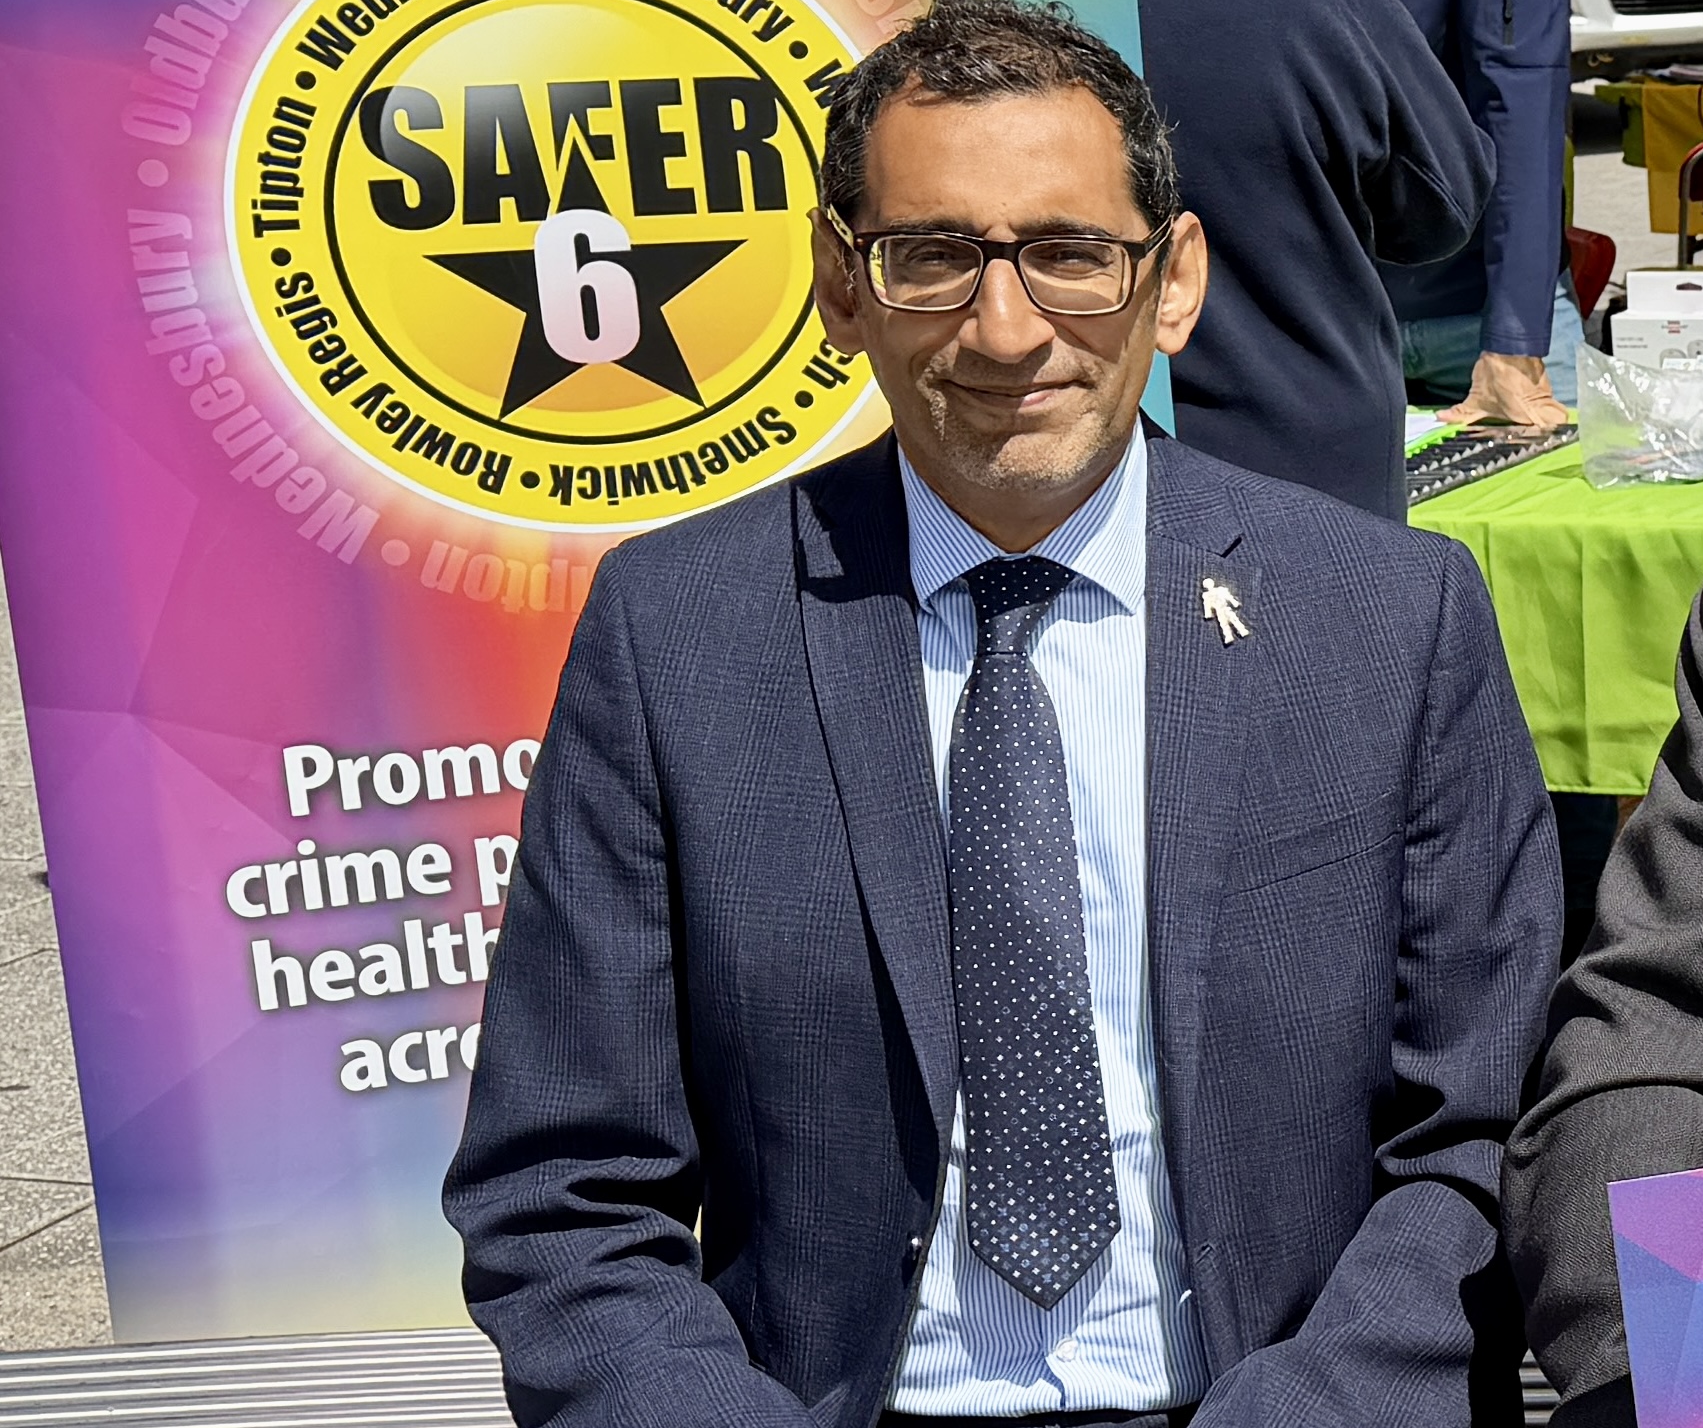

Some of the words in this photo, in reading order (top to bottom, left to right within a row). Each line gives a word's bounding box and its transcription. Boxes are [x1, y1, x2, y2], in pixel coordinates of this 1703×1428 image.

[251, 95, 317, 239] Tipton
[359, 76, 789, 231] SAFER
[275, 271, 368, 397] Regis
[534, 208, 641, 364] 6
[126, 207, 383, 568] Wednesbury
[351, 386, 513, 496] Rowley
[548, 405, 797, 506] Smethwick
[282, 737, 542, 818] Promo
[225, 839, 452, 918] crime
[250, 912, 501, 1012] health
